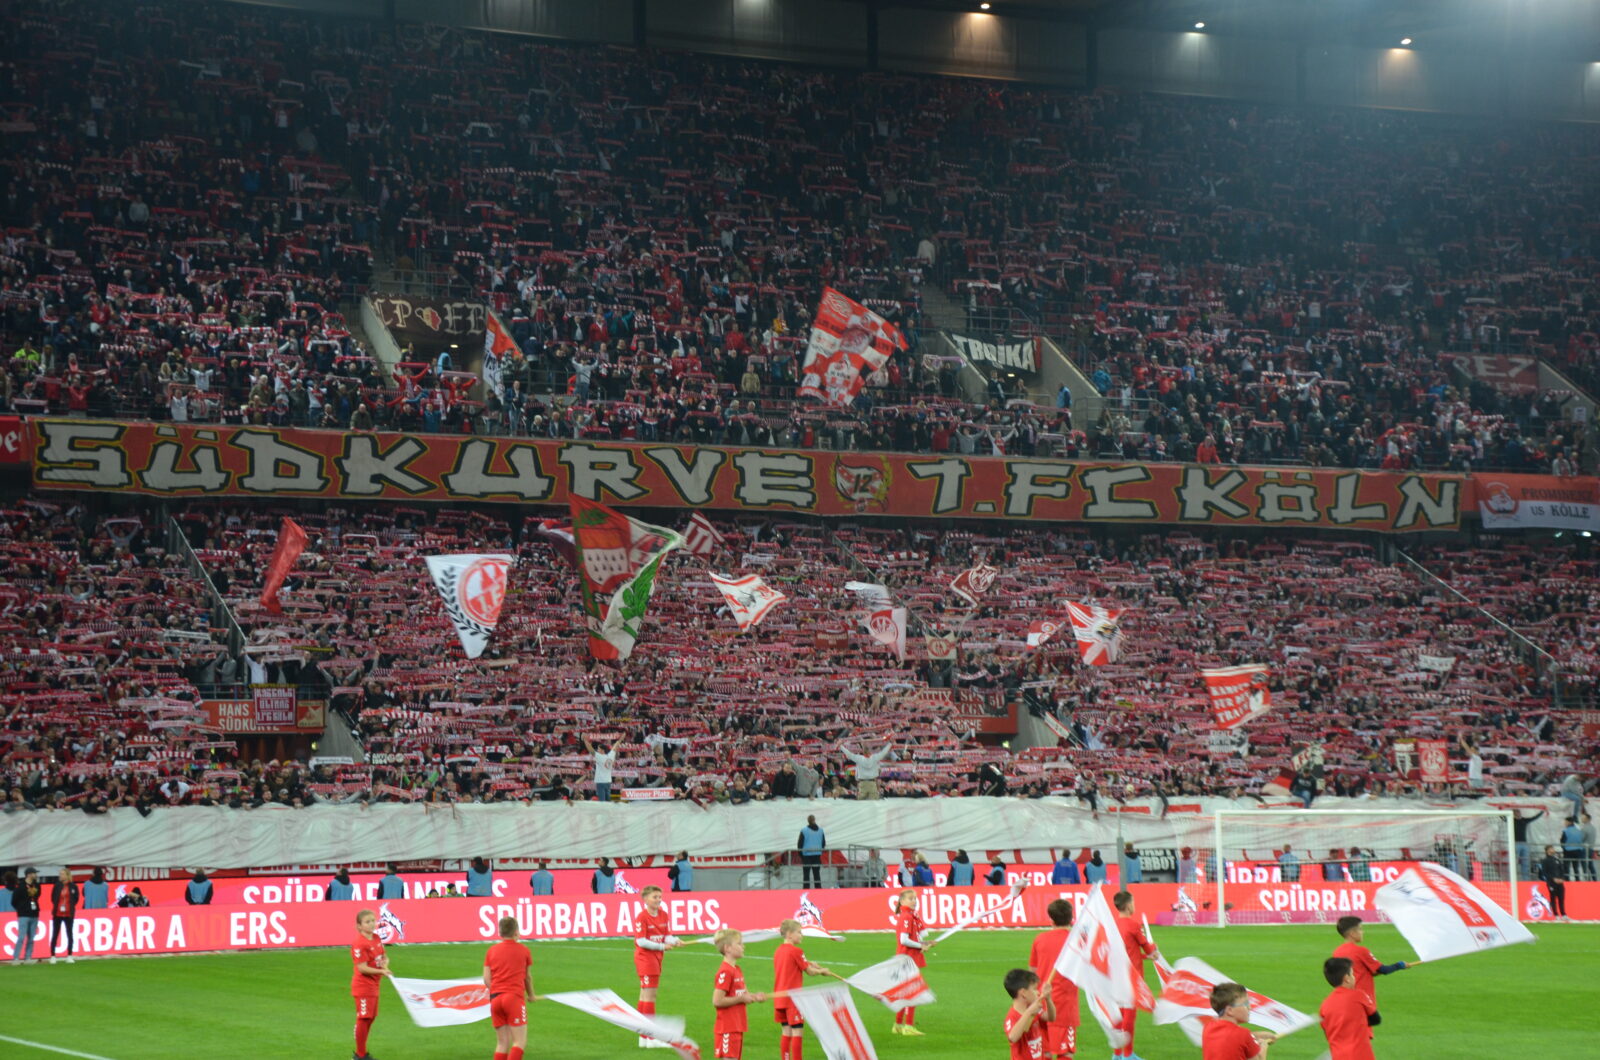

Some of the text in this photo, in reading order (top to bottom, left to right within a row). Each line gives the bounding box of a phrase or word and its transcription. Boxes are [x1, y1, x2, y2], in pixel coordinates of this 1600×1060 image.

[36, 419, 1462, 531] SÜDKURVE 1.FC KÖLN
[853, 473, 873, 494] 12
[1550, 502, 1591, 519] KÖLLE
[218, 703, 249, 717] HANS
[625, 790, 651, 799] Wiener
[1139, 856, 1176, 871] ERBOT
[888, 889, 1004, 926] SÜRBAR
